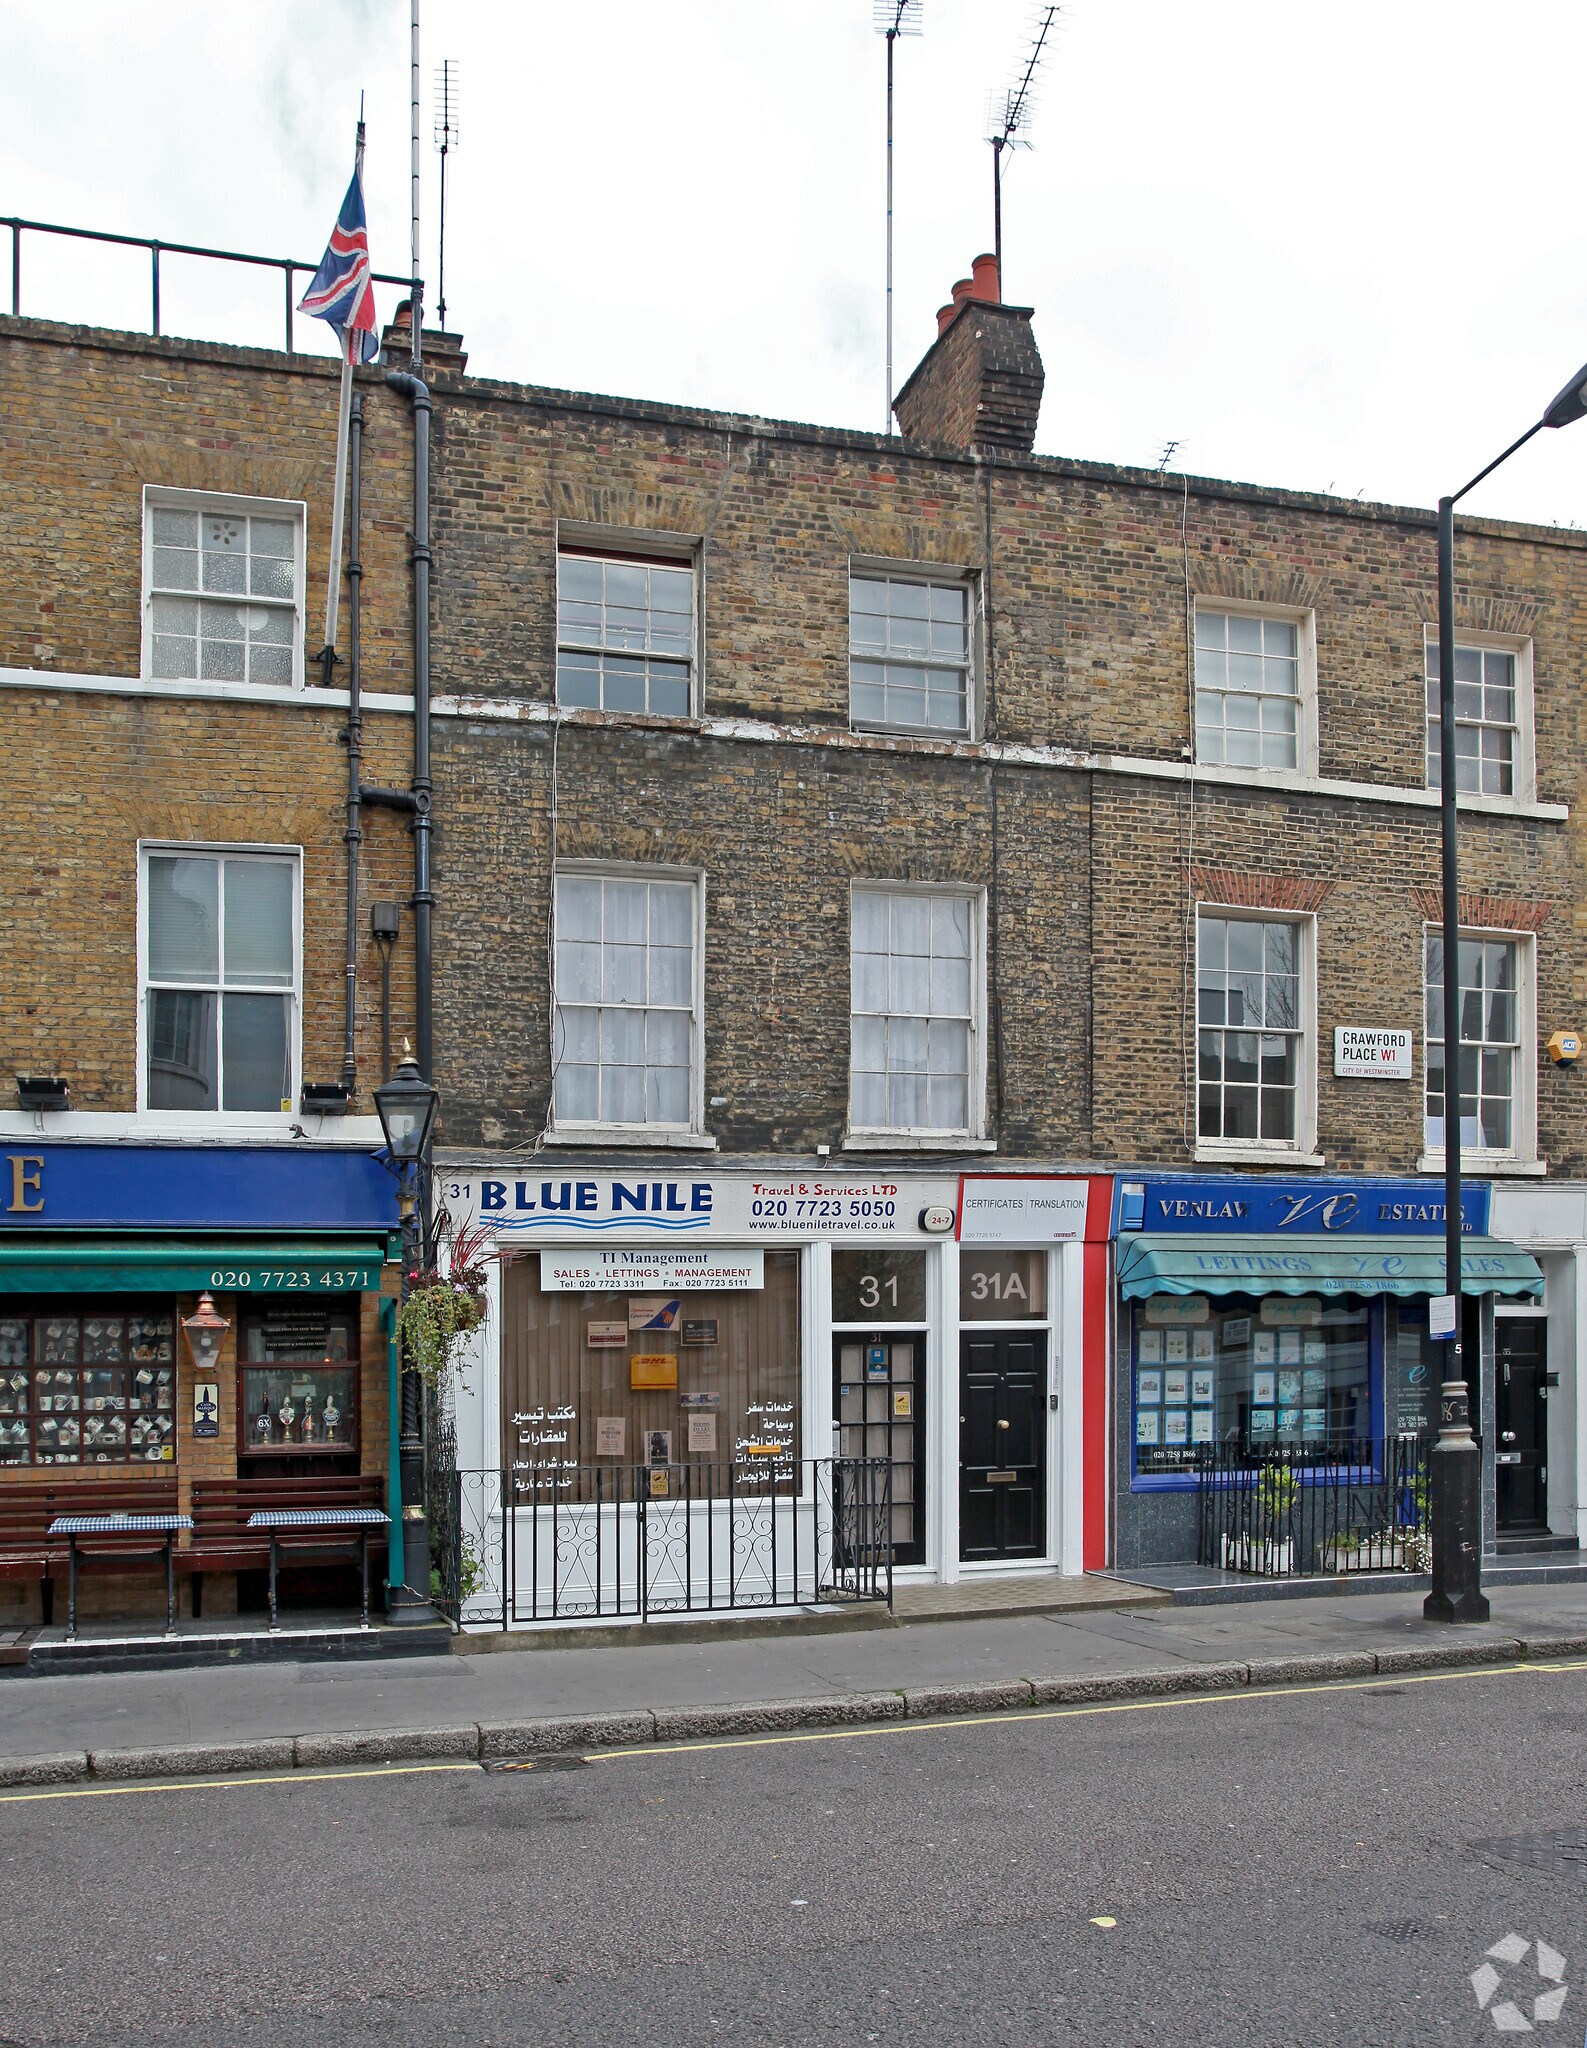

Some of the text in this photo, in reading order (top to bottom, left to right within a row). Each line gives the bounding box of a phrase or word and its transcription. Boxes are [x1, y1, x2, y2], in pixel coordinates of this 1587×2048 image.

[1342, 1031, 1406, 1047] CRAWFORD
[1563, 1041, 1576, 1049] ADT
[1342, 1047, 1396, 1062] PLACE W1
[5, 1155, 46, 1212] E
[752, 1183, 898, 1196] Travel & Services LTD
[450, 1183, 471, 1199] 31
[480, 1181, 714, 1212] BLUE NILE
[752, 1200, 896, 1217] 020 7723 5050
[965, 1199, 1085, 1209] CERTIFICATES TRANSLATION
[1159, 1199, 1249, 1219] VENLAW
[748, 1219, 896, 1230] www.blueniletravel.co.uk
[931, 1216, 950, 1224] 24-7
[1460, 1223, 1473, 1232] TD
[599, 1252, 709, 1266] TI Management
[1196, 1255, 1313, 1271] LETTINGS
[210, 1271, 369, 1287] 020 7723 4371
[553, 1268, 752, 1278] SALES LETTINGS MANAGEMENT
[559, 1280, 645, 1288] Tel: 020 7723 3311
[663, 1279, 748, 1287] Fax: 020 7723 5111
[970, 1272, 1028, 1299] 31A
[1325, 1280, 1400, 1290] 020 7258 1866
[859, 1275, 898, 1307] 31
[870, 1333, 881, 1342] 31
[1454, 1343, 1462, 1354] 5
[510, 1405, 577, 1425] مكتب تيسير
[744, 1401, 794, 1415] خدمات سفر
[258, 1419, 270, 1428] 6X
[762, 1418, 794, 1432] وسياحة
[519, 1429, 568, 1446] للعقارات
[765, 1435, 794, 1446] خدمات
[1153, 1451, 1165, 1459] 020
